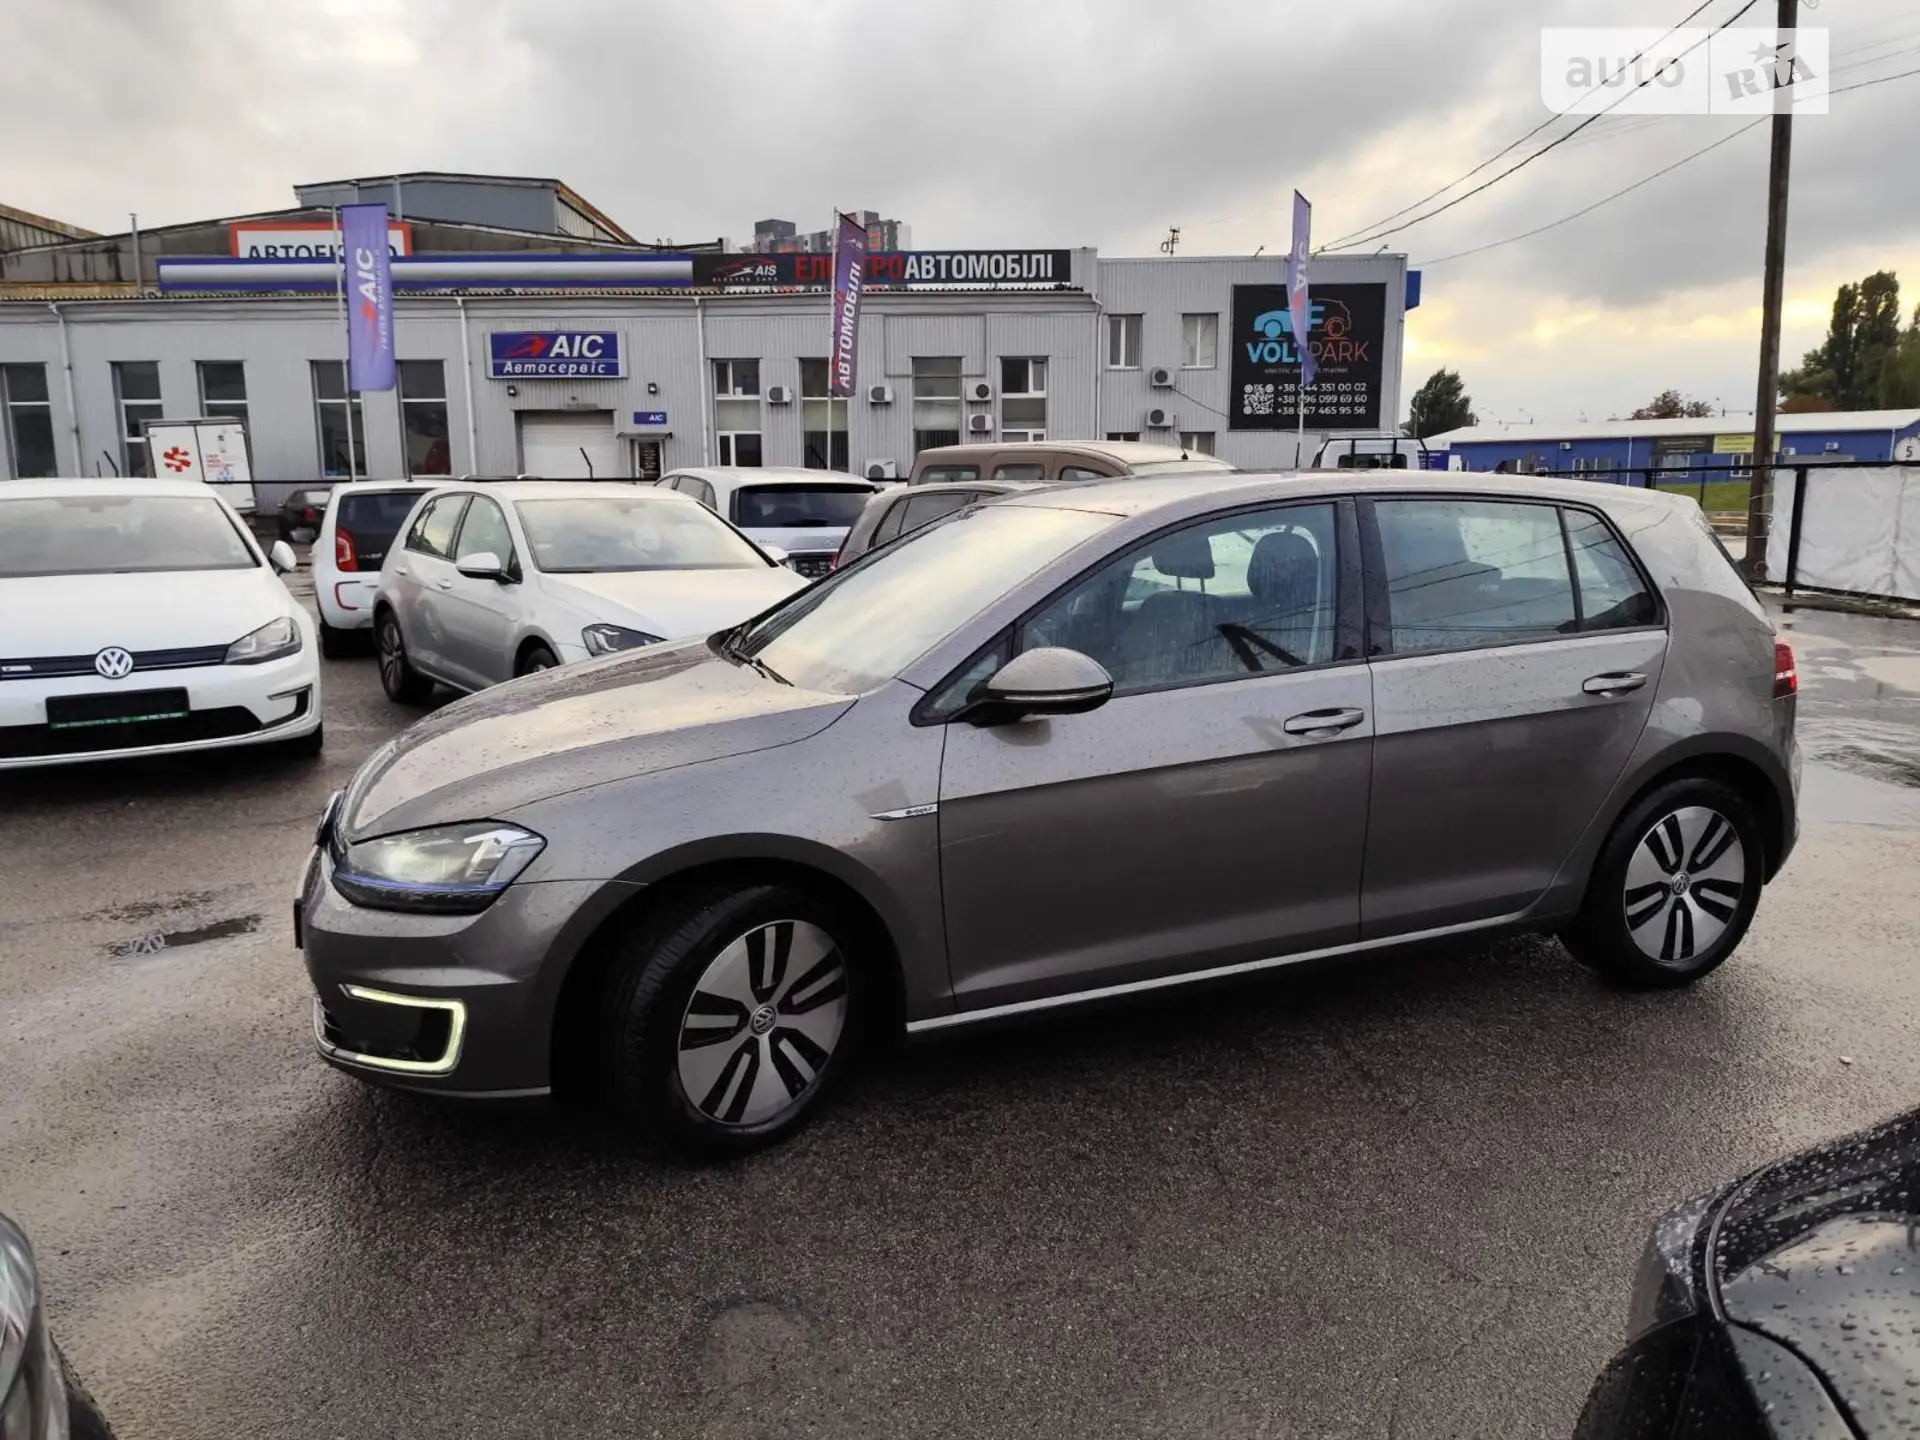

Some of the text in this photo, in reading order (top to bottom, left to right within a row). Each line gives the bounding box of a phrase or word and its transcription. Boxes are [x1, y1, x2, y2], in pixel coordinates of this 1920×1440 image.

[754, 264, 777, 277] AIS
[838, 261, 861, 389] АВТОМОБІЛІ
[503, 360, 606, 376] Автосервіс
[1278, 384, 1295, 392] +38
[1320, 383, 1336, 392] 351
[1338, 383, 1351, 392] 00
[1353, 383, 1367, 391] 02
[1278, 395, 1295, 403] +38
[1318, 395, 1338, 403] 099
[1339, 394, 1352, 403] 69
[1277, 407, 1294, 415] +38
[1318, 406, 1337, 415] 465
[1339, 406, 1351, 415] 95
[1353, 406, 1366, 415] 56
[1905, 445, 1913, 458] 5
